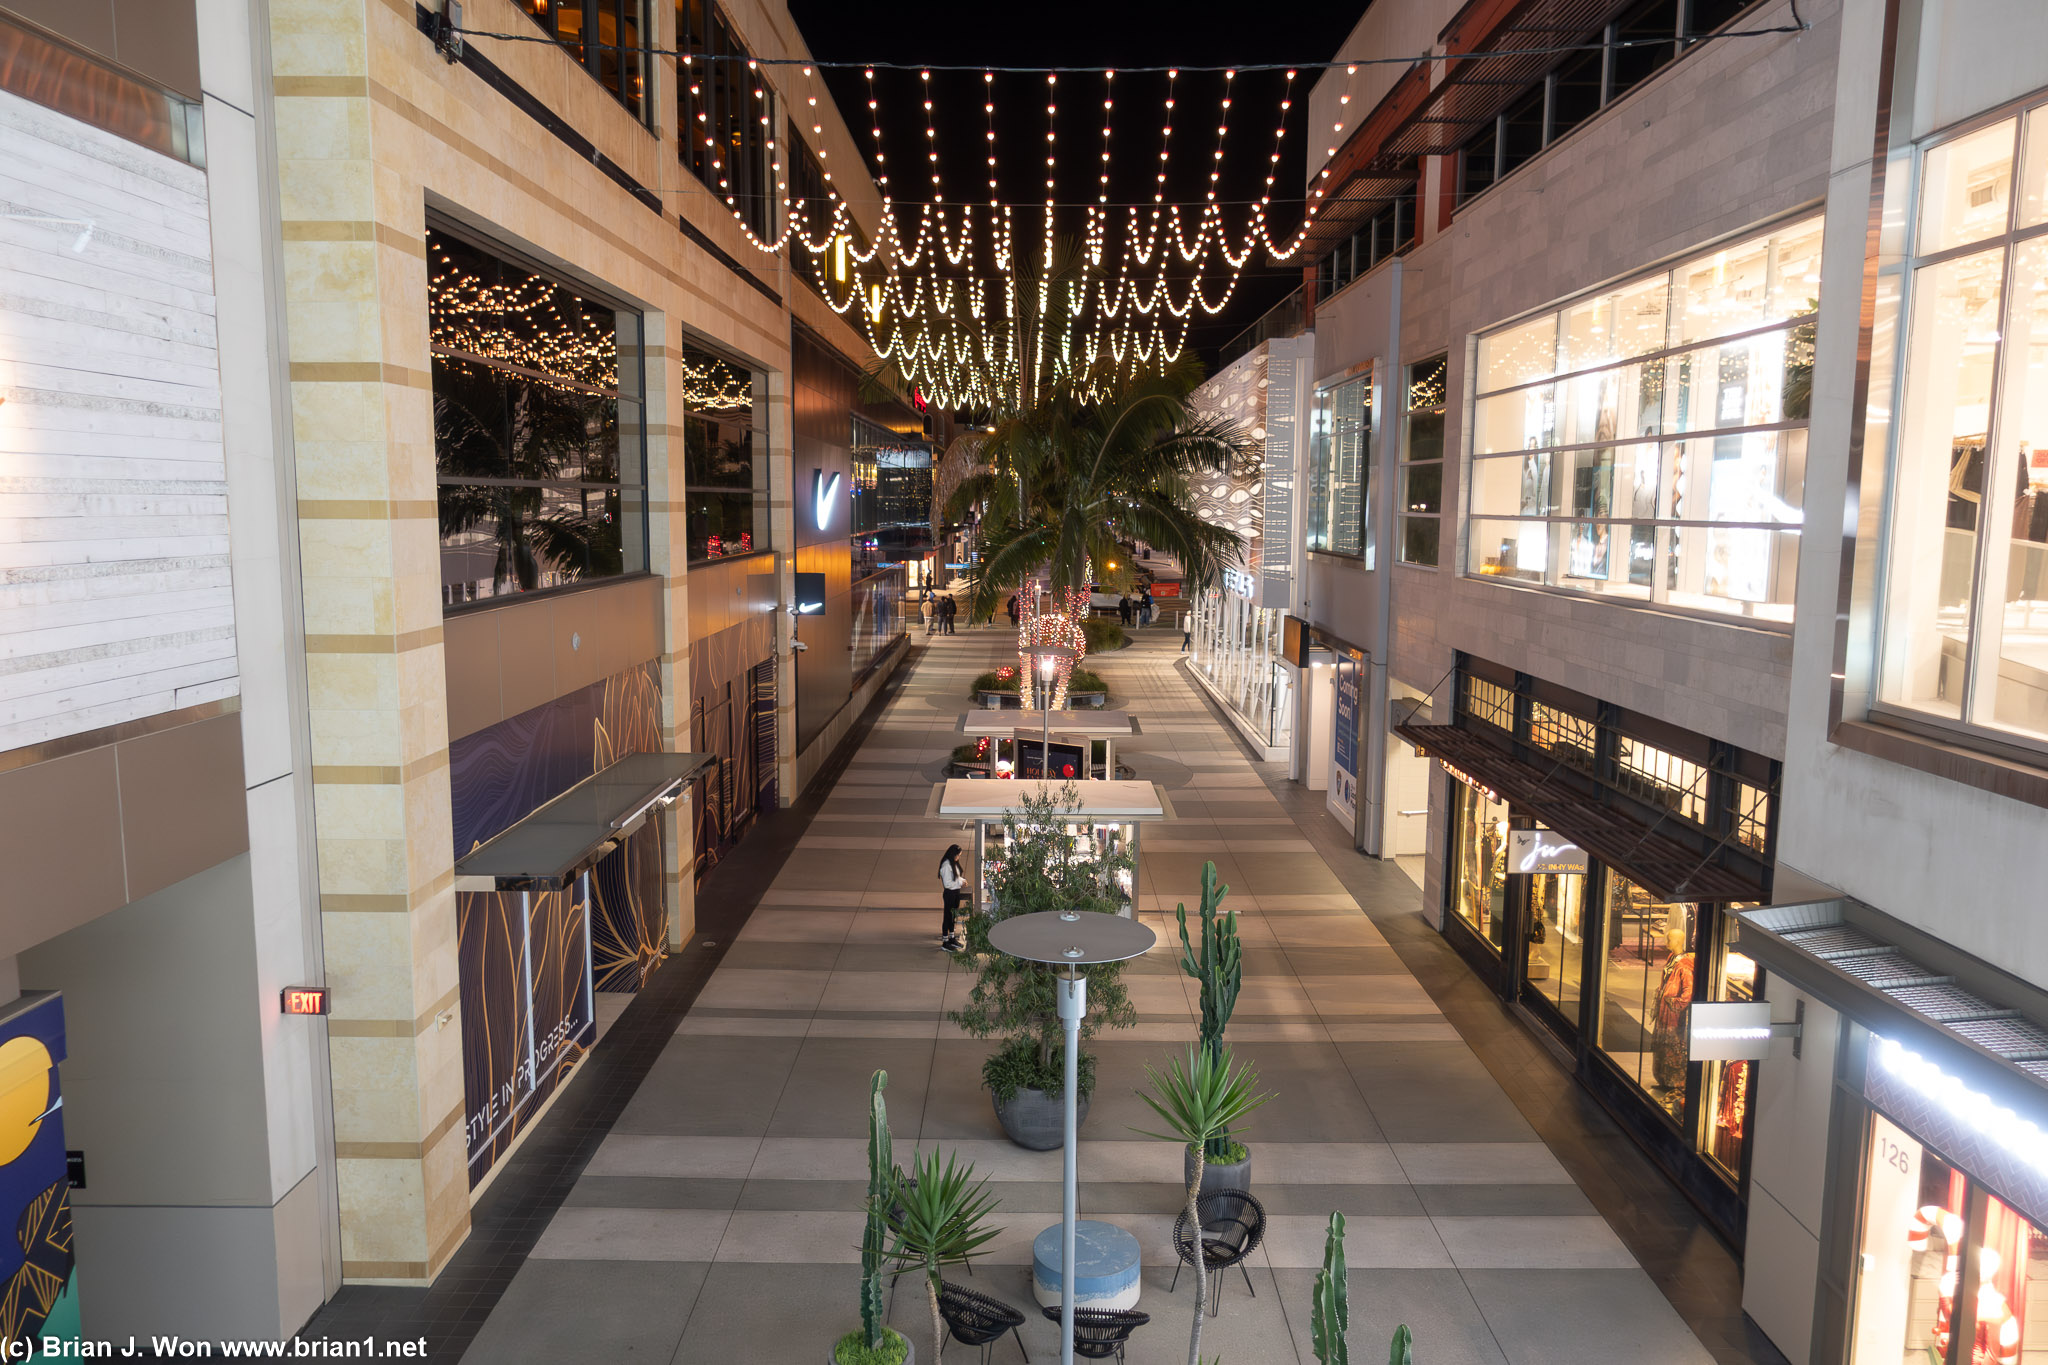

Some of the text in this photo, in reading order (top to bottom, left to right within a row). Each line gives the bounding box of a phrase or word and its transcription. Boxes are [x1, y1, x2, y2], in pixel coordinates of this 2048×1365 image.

[1339, 674, 1358, 705] Coming
[1338, 697, 1351, 720] Soon
[291, 992, 323, 1014] EXIT
[502, 1075, 515, 1107] IN
[1881, 1137, 1909, 1175] 126
